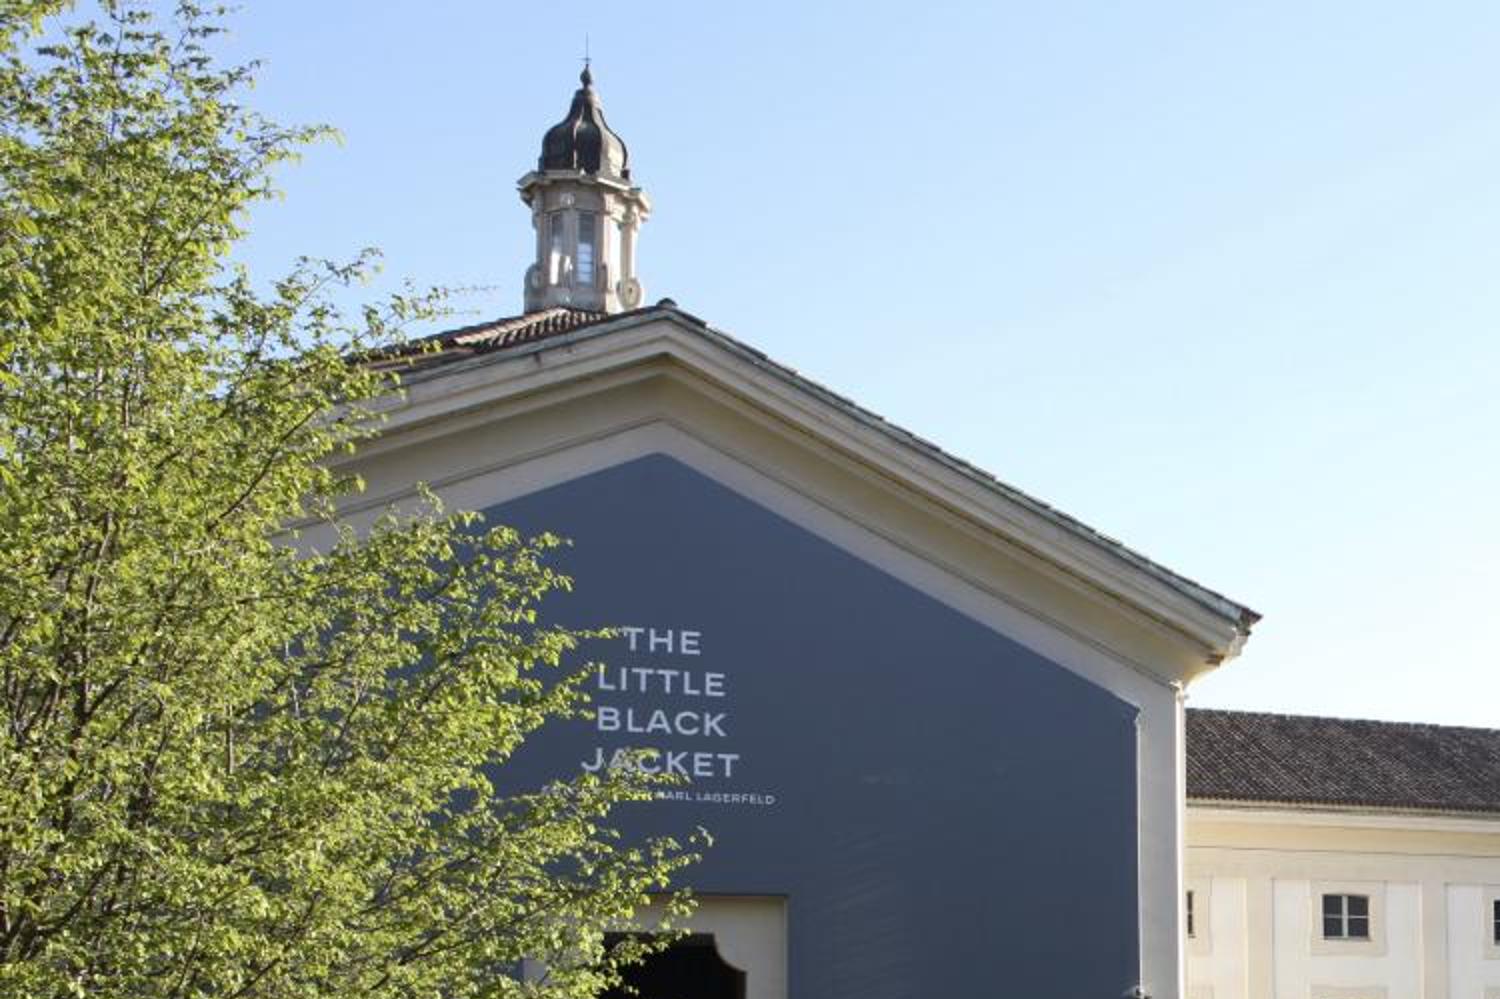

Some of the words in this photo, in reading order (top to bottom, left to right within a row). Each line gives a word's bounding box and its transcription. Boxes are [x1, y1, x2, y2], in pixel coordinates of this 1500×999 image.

[622, 627, 701, 655] THE
[598, 664, 726, 697] LITTLE
[597, 706, 727, 737] BLACK
[580, 748, 740, 778] JACKET
